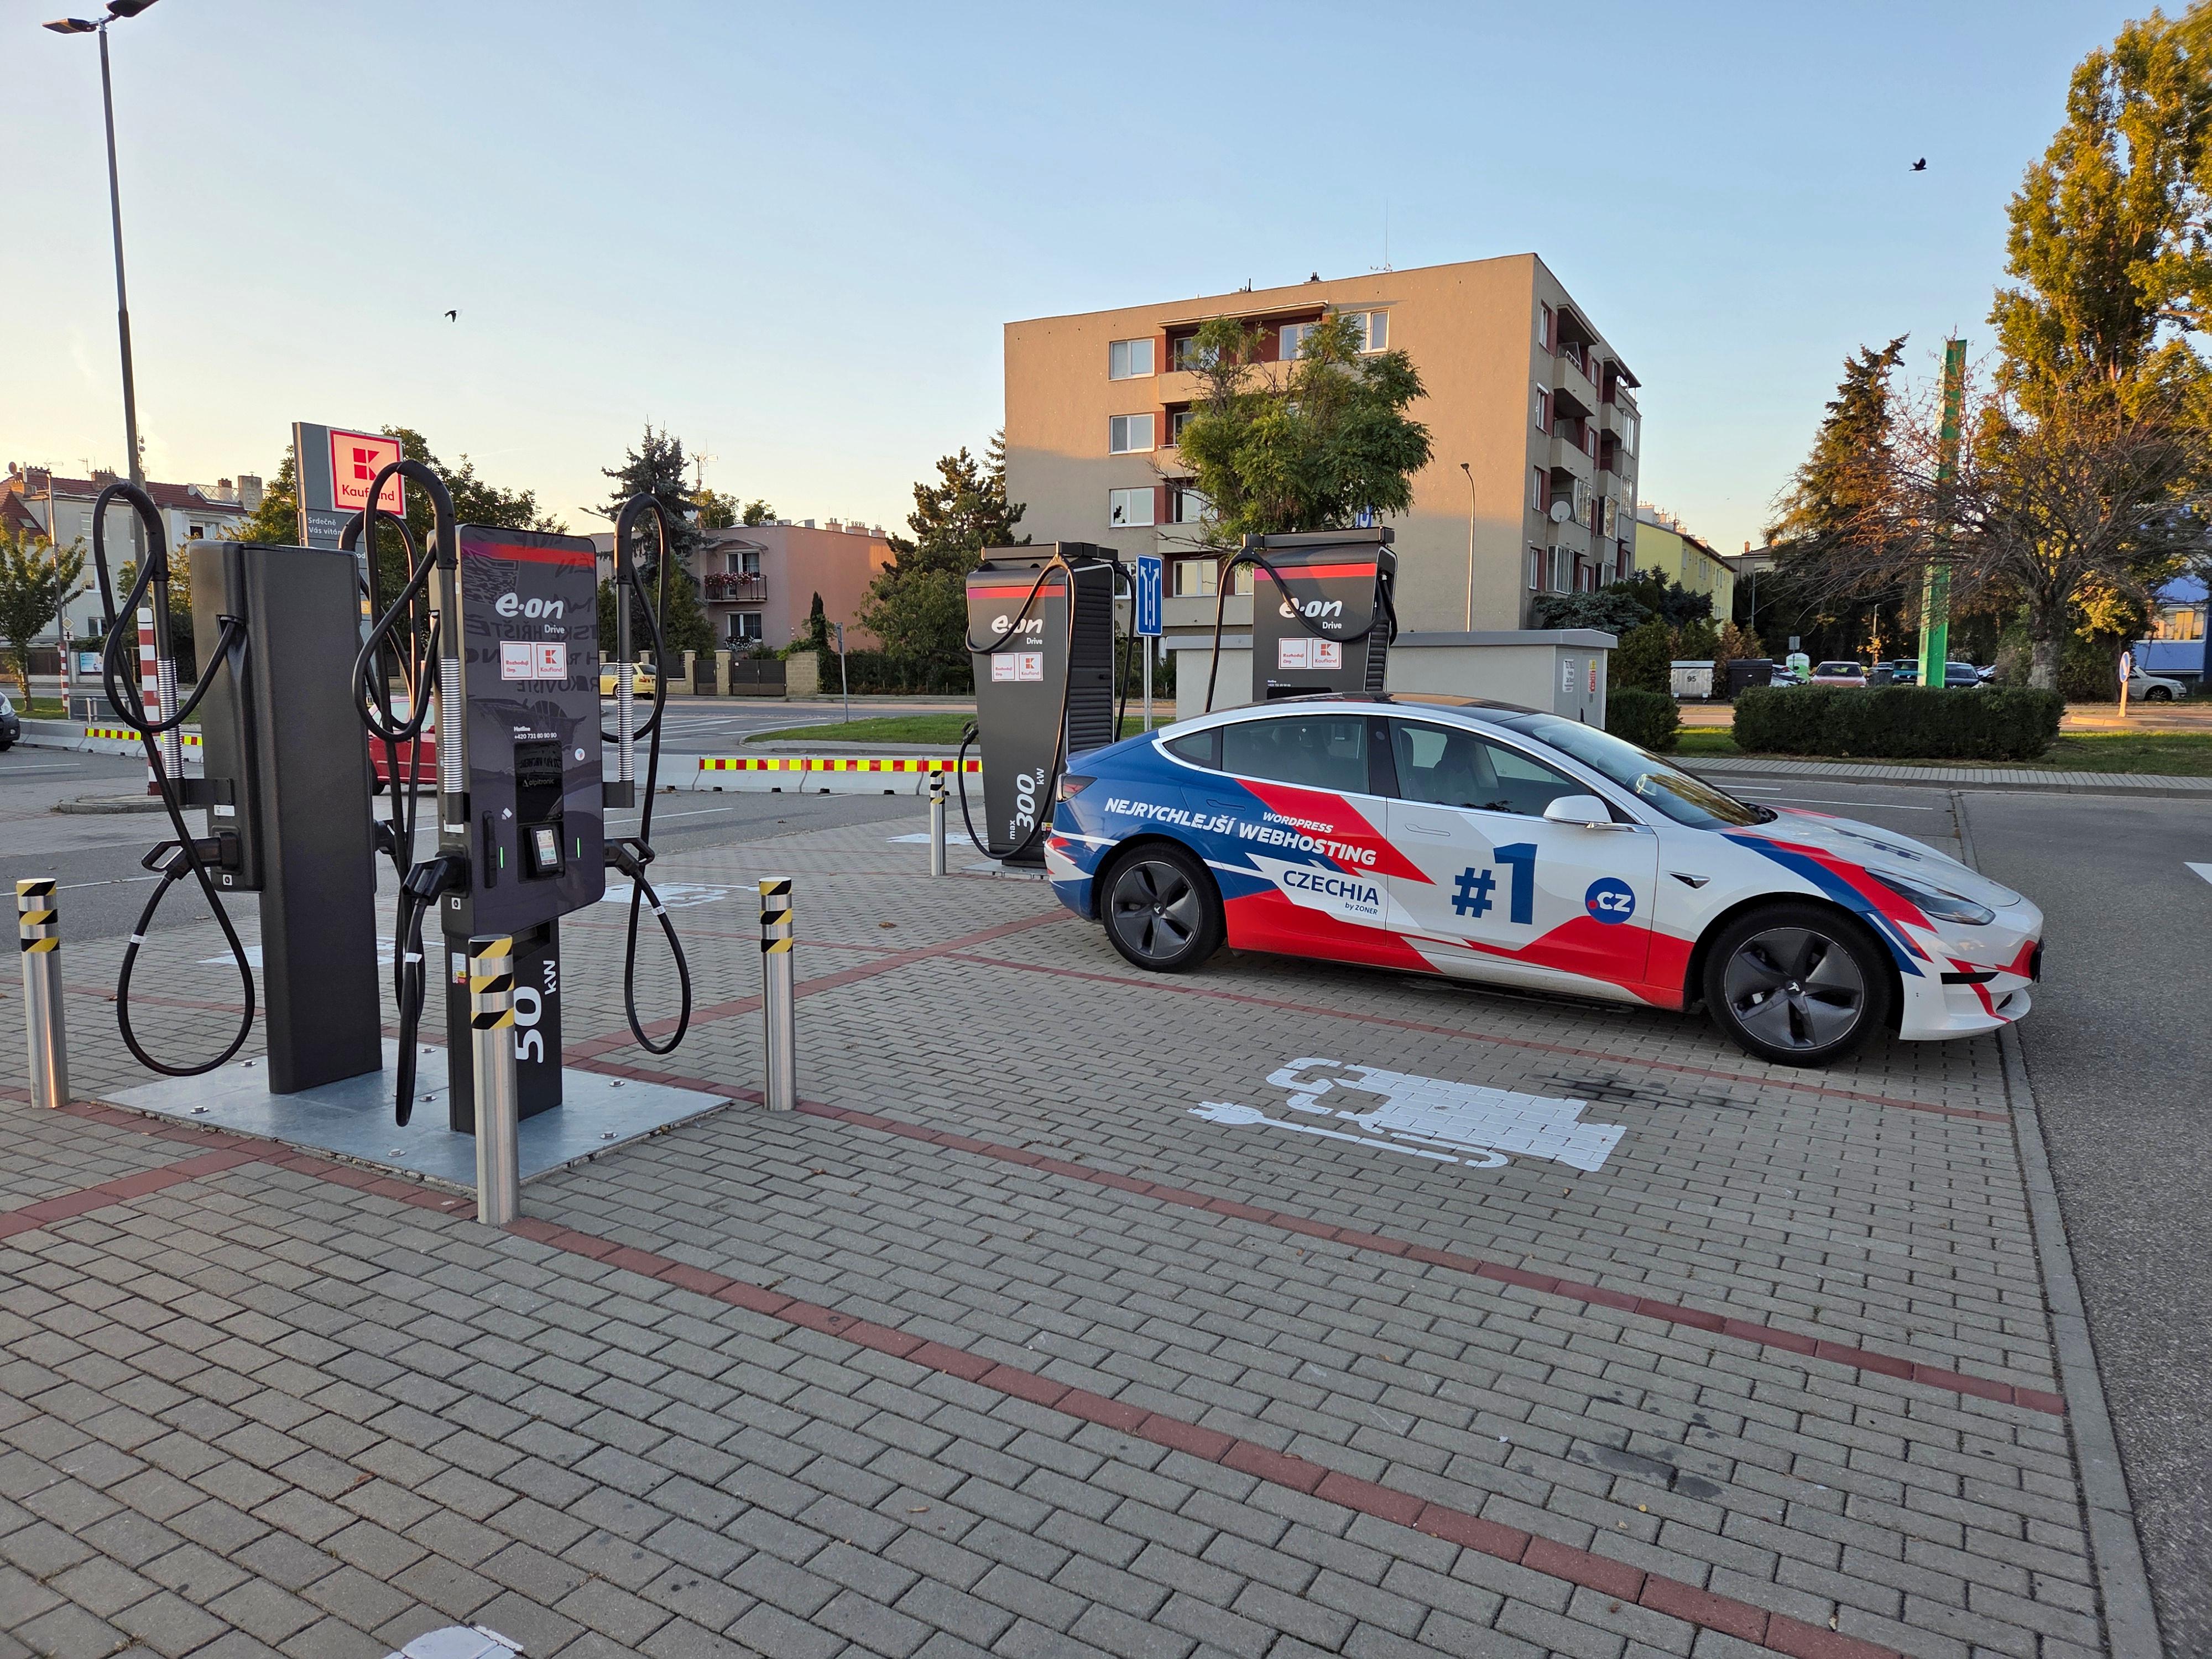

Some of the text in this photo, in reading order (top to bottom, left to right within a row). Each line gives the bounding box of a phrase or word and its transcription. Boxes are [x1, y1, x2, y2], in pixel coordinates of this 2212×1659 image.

[342, 484, 394, 501] Kaufnd
[308, 517, 336, 525] Srdečně
[544, 624, 565, 634] Drive
[1322, 621, 1342, 629] Drive
[1036, 768, 1045, 785] kW
[1016, 774, 1035, 833] 300
[1104, 798, 1376, 865] NEJRYCHLEJŠÍ WEBHOSTING
[1262, 812, 1334, 833] WORDPRESS
[1284, 870, 1379, 906] CZECHIA
[1452, 843, 1538, 925] #1
[1345, 902, 1378, 915] by ZONER
[543, 961, 556, 995] kW
[514, 987, 544, 1063] 50
